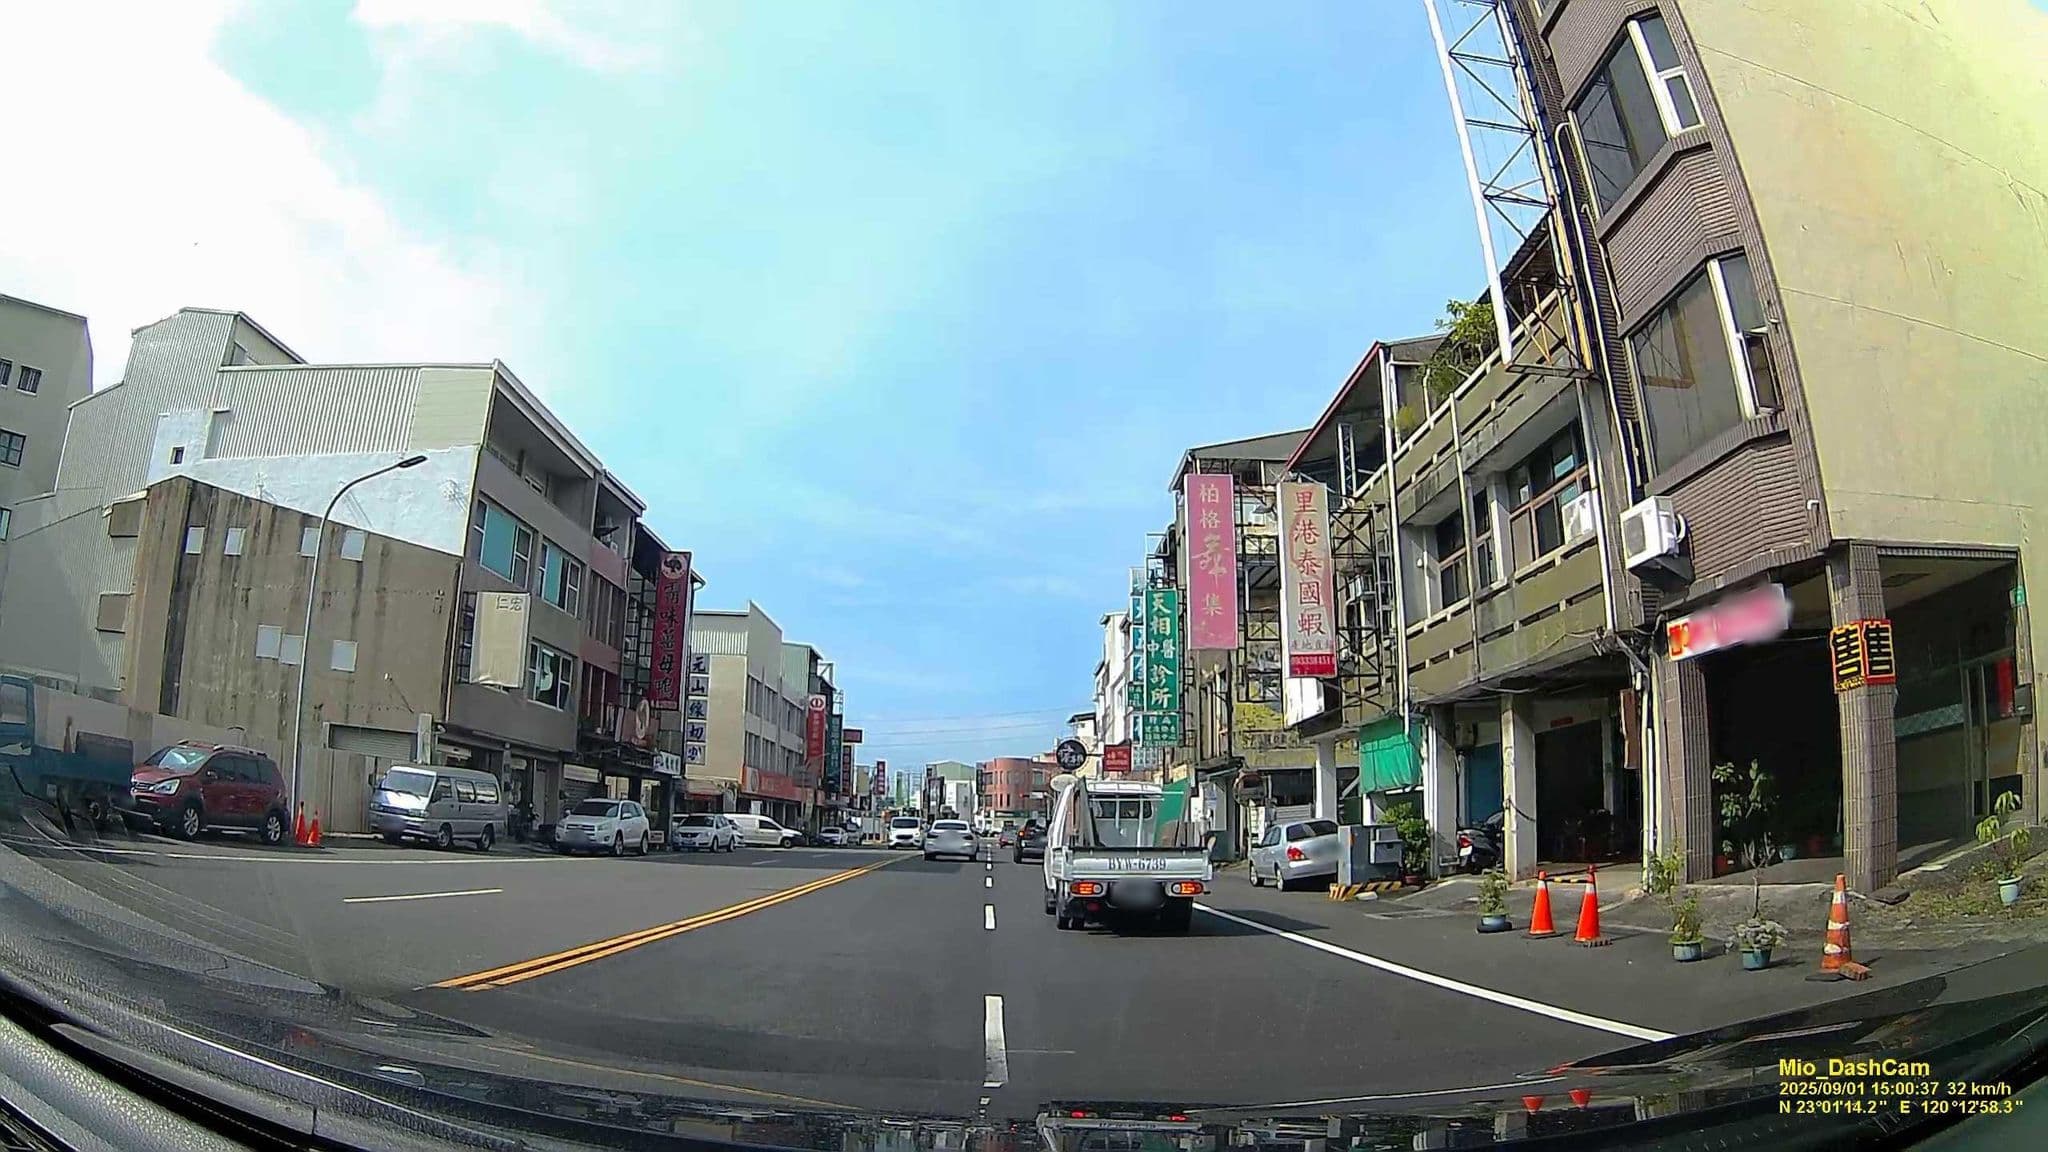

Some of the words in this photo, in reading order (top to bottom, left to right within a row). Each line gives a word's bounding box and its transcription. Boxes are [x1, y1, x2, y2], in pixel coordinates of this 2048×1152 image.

[1293, 491, 1326, 636] 里港泰國蝦
[1831, 625, 1861, 680] 售
[1863, 621, 1894, 676] 售
